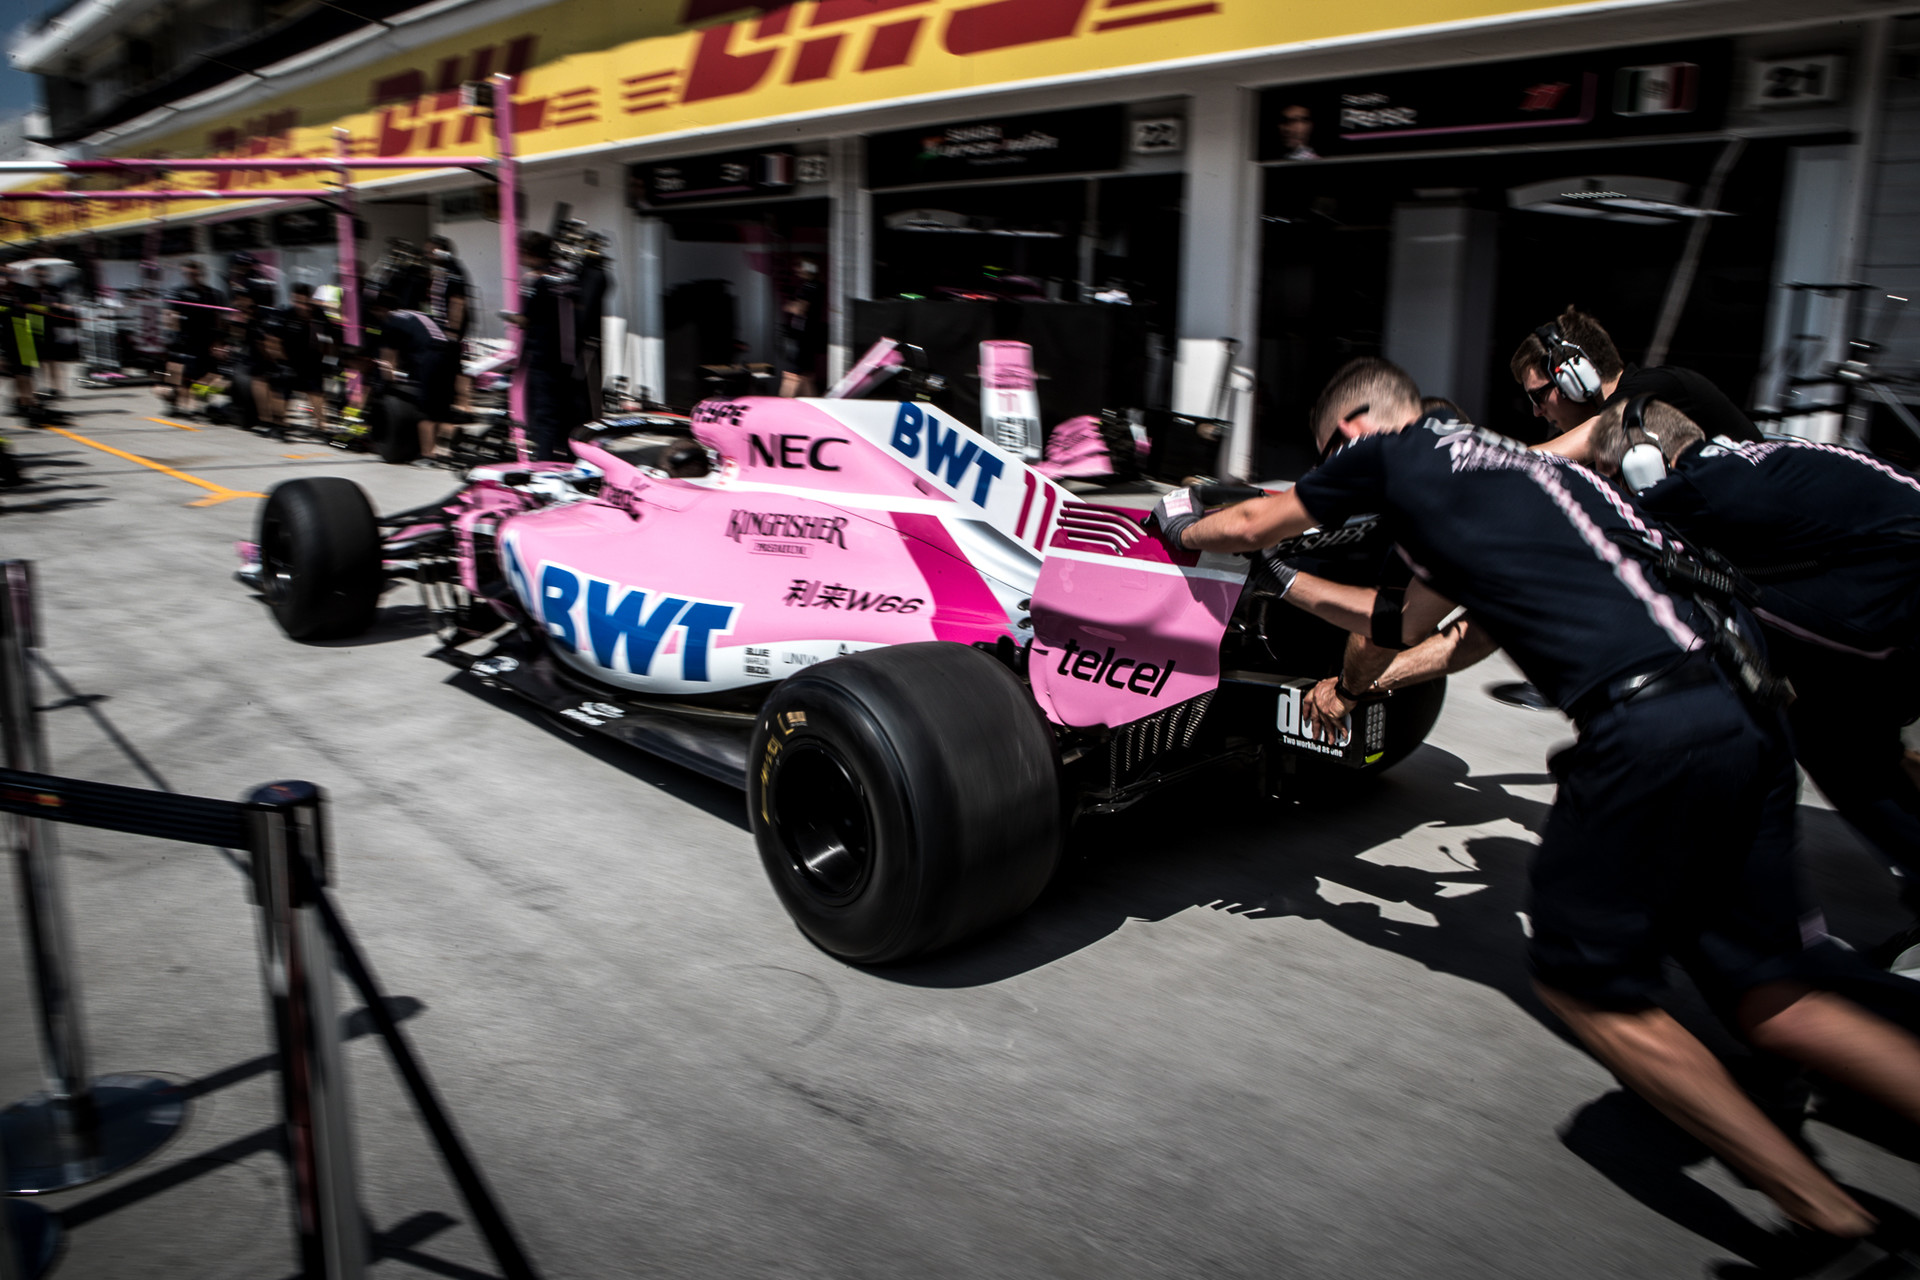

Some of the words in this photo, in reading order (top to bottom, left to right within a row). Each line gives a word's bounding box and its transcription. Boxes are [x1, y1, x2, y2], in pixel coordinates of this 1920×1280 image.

[370, 34, 548, 158] DHL
[1762, 64, 1825, 99] 21
[748, 433, 851, 472] NEC
[890, 401, 1005, 509] BWT
[725, 509, 848, 550] KINGFISHER
[1015, 468, 1056, 553] 11
[541, 565, 735, 682] BWT
[1057, 638, 1176, 698] telcel
[1283, 735, 1296, 746] Two
[1296, 740, 1321, 753] working
[1322, 746, 1330, 755] as
[1330, 748, 1343, 757] one
